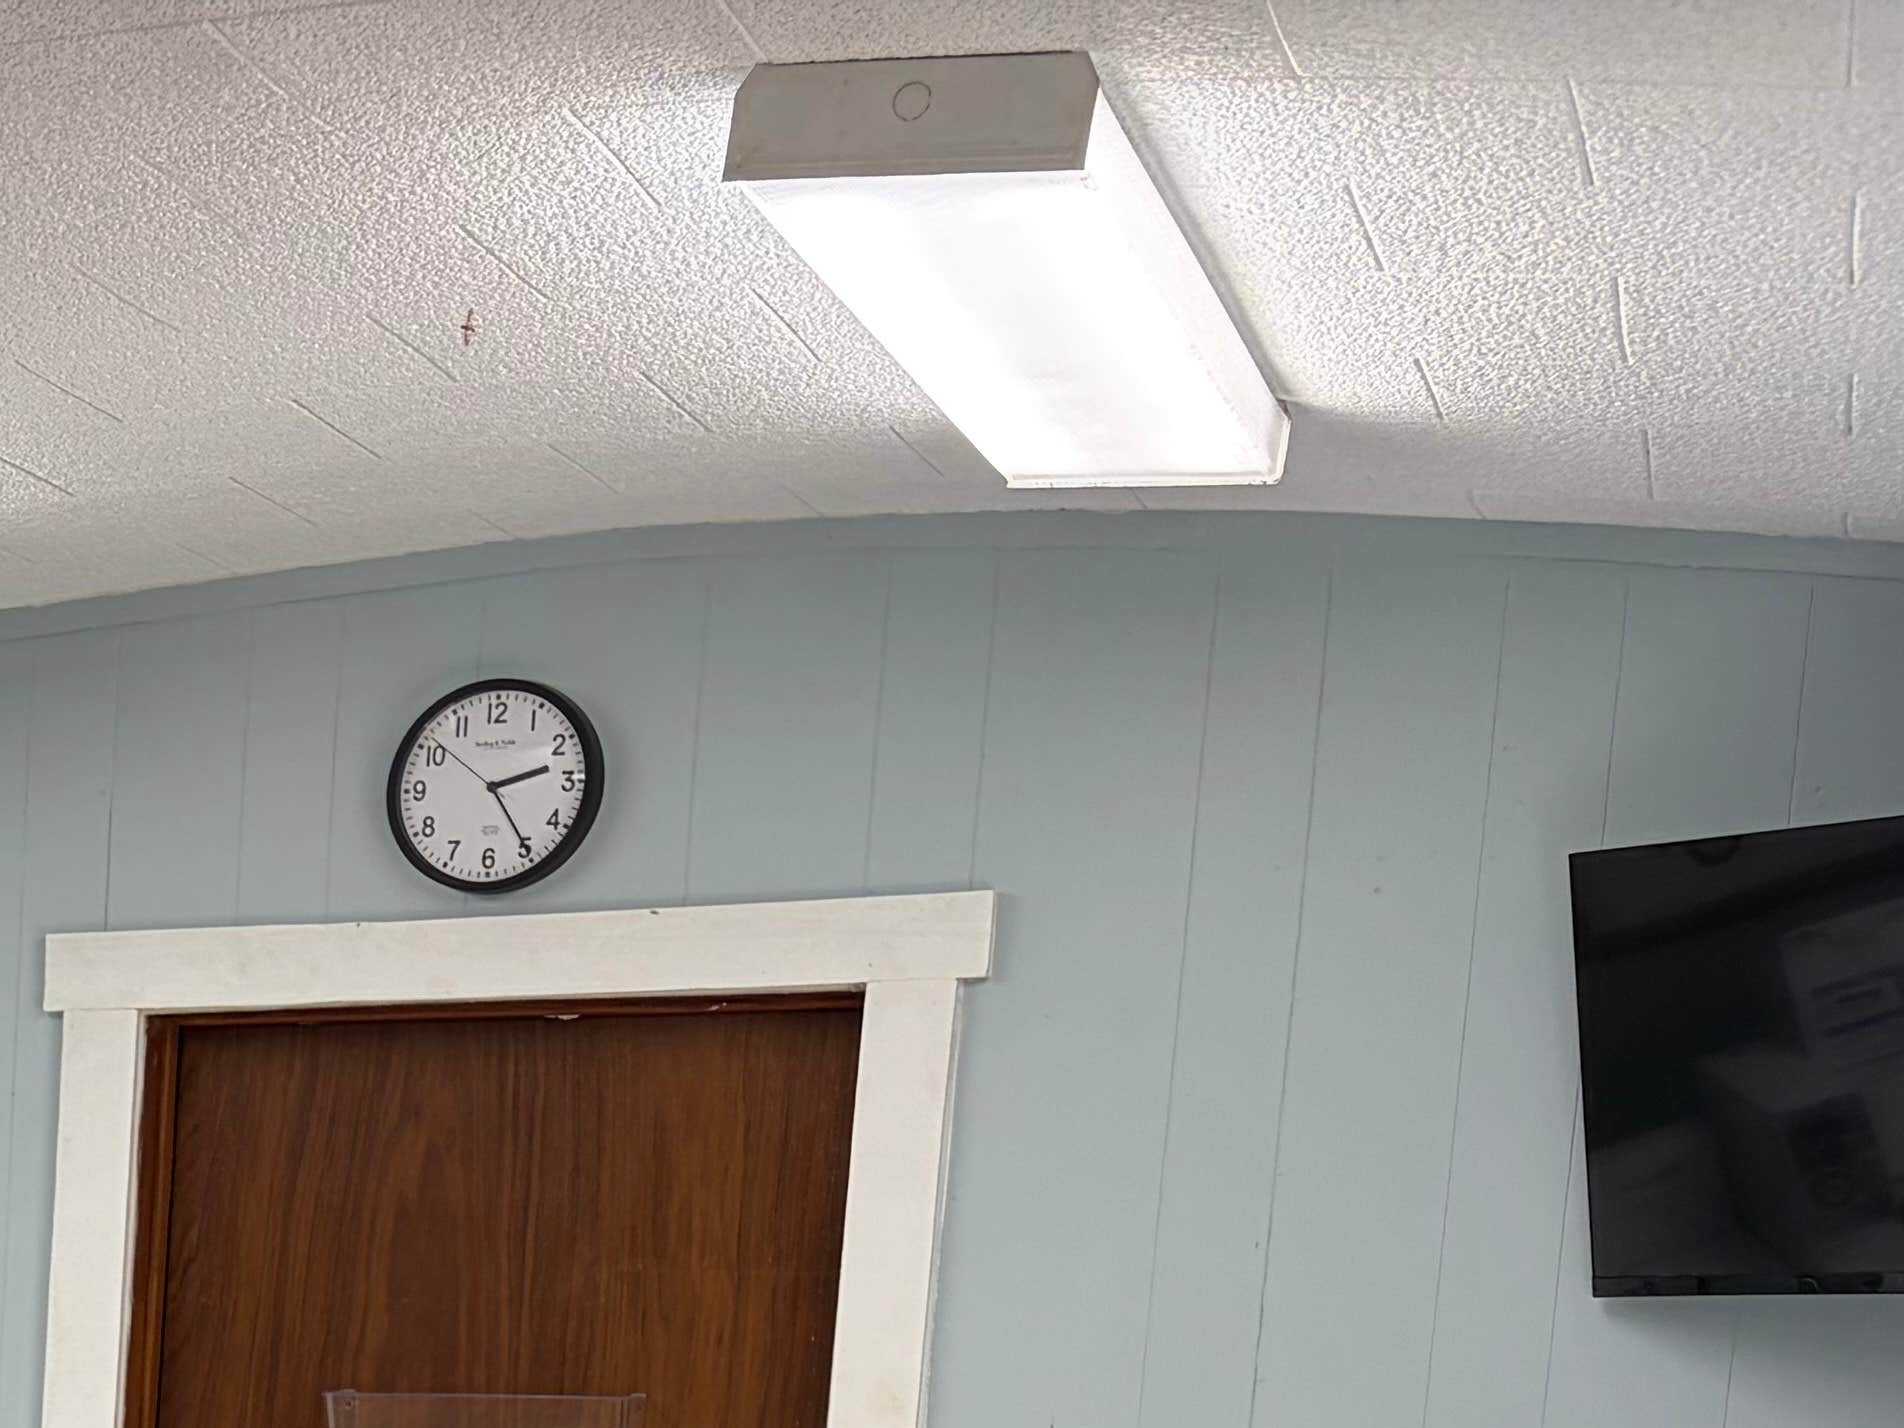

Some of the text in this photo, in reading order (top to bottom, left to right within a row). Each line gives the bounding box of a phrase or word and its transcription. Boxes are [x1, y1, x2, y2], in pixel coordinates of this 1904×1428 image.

[488, 702, 508, 725] 12
[531, 708, 537, 732] 1
[455, 715, 469, 738] 11
[551, 733, 567, 757] 2
[425, 746, 446, 768] 10
[412, 779, 427, 802] 9
[561, 769, 577, 793] 3
[421, 815, 436, 838] 8
[545, 807, 562, 831] 4
[447, 839, 462, 862] 7
[481, 847, 496, 870] 6
[518, 836, 533, 859] 5
